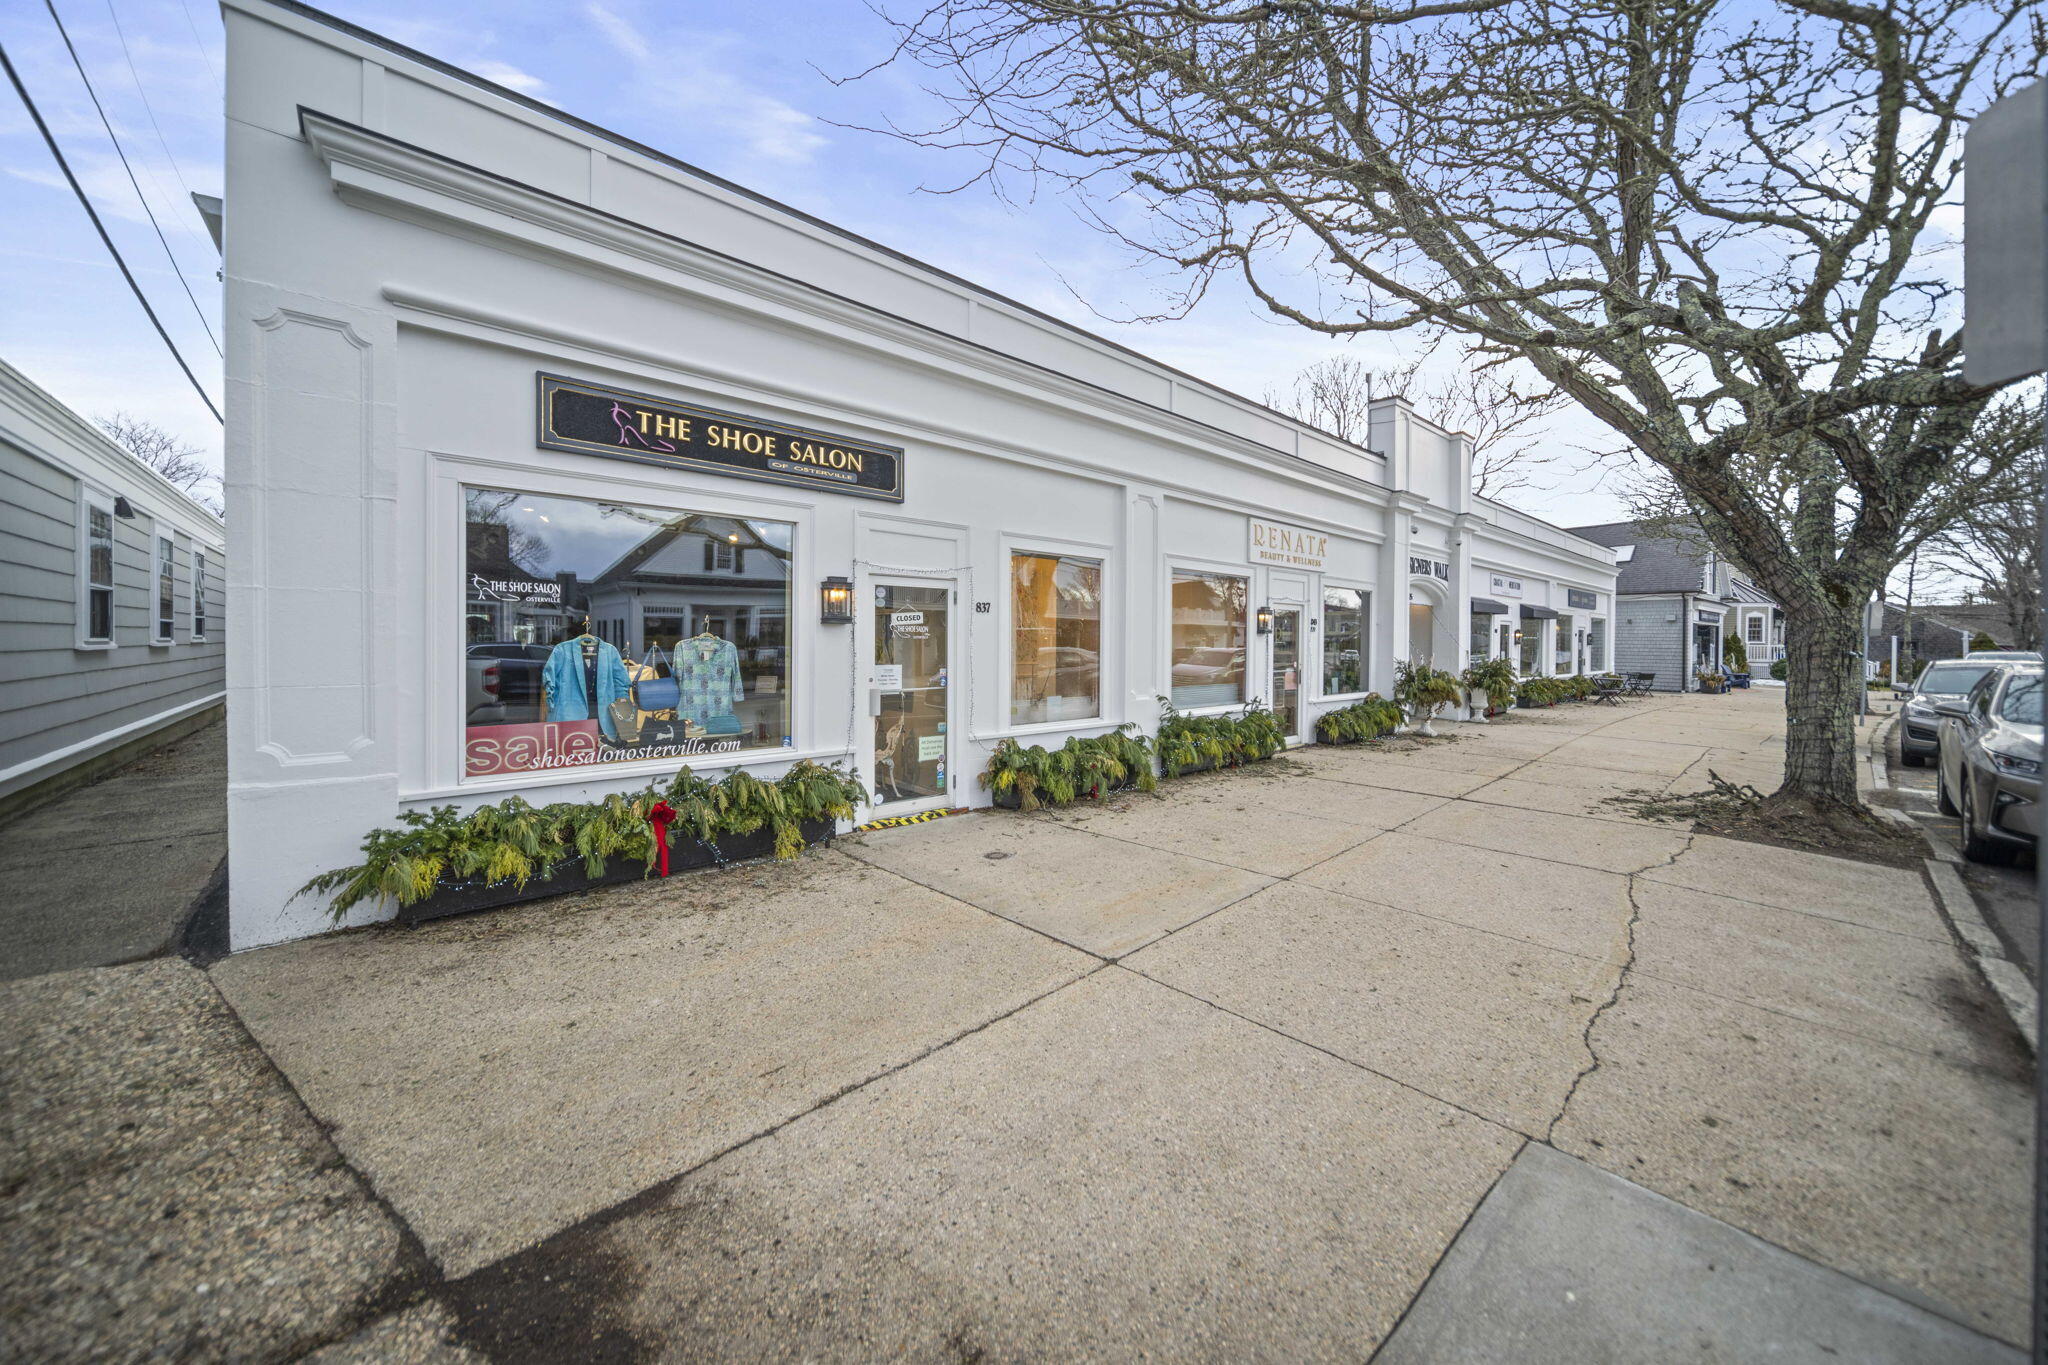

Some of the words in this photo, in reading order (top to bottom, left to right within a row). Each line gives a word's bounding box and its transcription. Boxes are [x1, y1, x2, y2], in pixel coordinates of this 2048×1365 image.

[636, 410, 691, 442] THE
[707, 425, 776, 457] SHOE
[790, 441, 863, 473] SALON
[771, 461, 789, 470] OF
[793, 465, 854, 480] OSTERVILLE
[1253, 523, 1327, 557] RENATA
[1260, 550, 1285, 562] BEAUTY
[1293, 556, 1322, 567] WELLNESS
[1410, 557, 1432, 576] SIGNERS
[1434, 562, 1449, 582] WALK
[490, 580, 507, 592] THE
[508, 581, 533, 593] SHOE
[534, 583, 561, 594] SALON
[896, 614, 921, 622] CLOSED
[975, 601, 991, 613] 837
[466, 724, 595, 773] sale
[529, 738, 741, 770] shoesalonosterville.com
